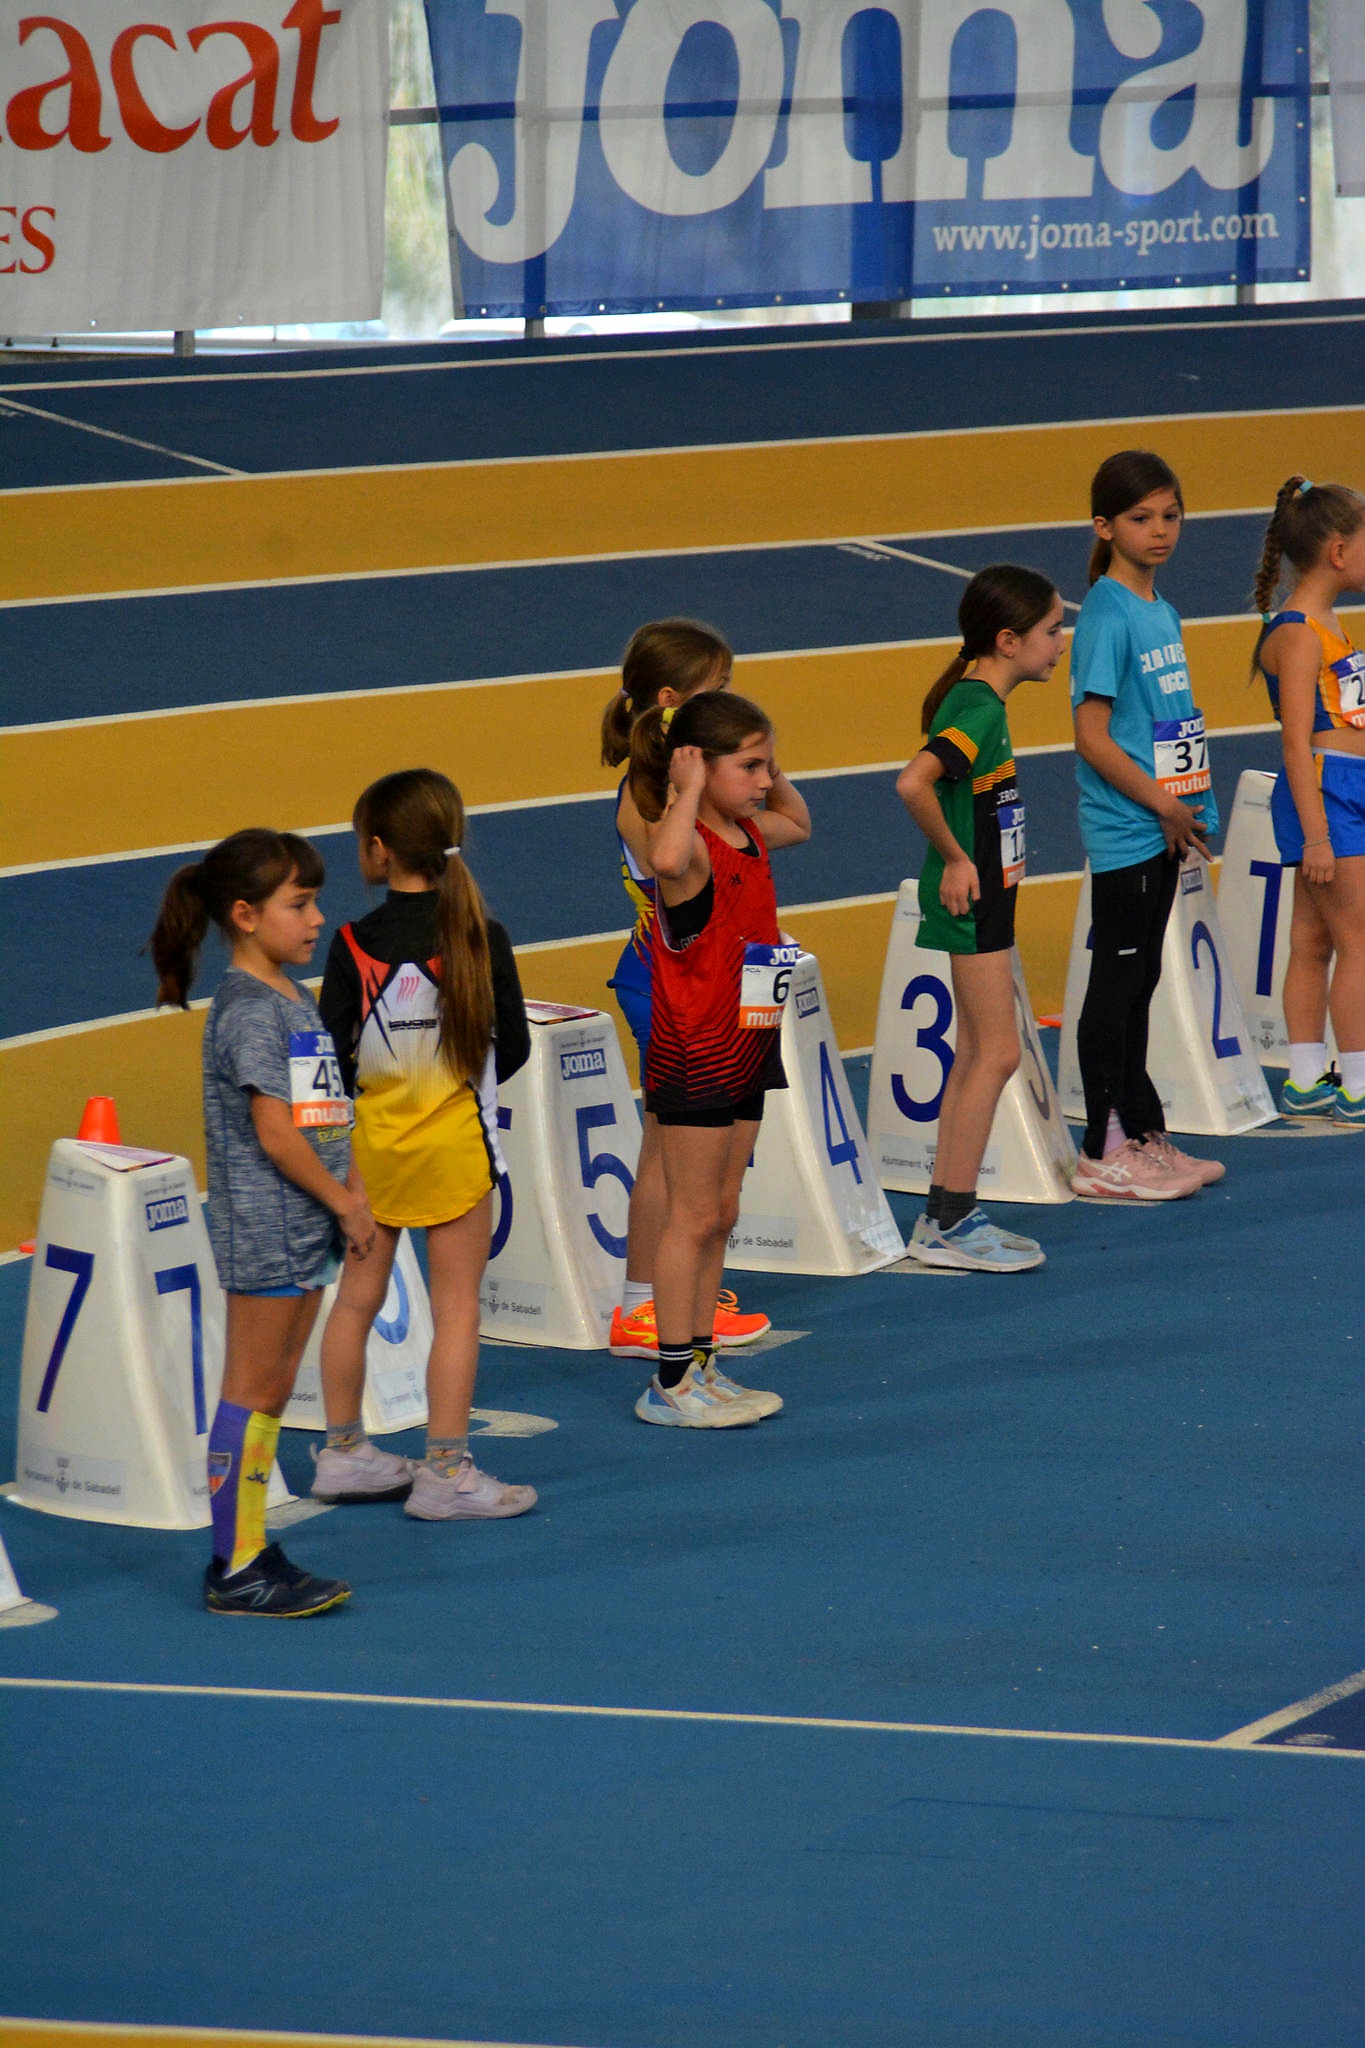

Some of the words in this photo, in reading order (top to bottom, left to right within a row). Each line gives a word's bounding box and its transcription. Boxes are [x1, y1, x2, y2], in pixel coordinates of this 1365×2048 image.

[0, 0, 343, 153] acat
[933, 212, 1280, 260] www.joma-sport.com
[1164, 773, 1211, 794] mutu
[1174, 738, 1206, 773] 37
[1191, 920, 1242, 1059] 2
[1249, 859, 1283, 997] 1
[819, 1041, 863, 1185] 4
[890, 974, 957, 1123] 3
[575, 1102, 634, 1260] 5
[36, 1243, 94, 1413] 7
[154, 1262, 207, 1435] 7
